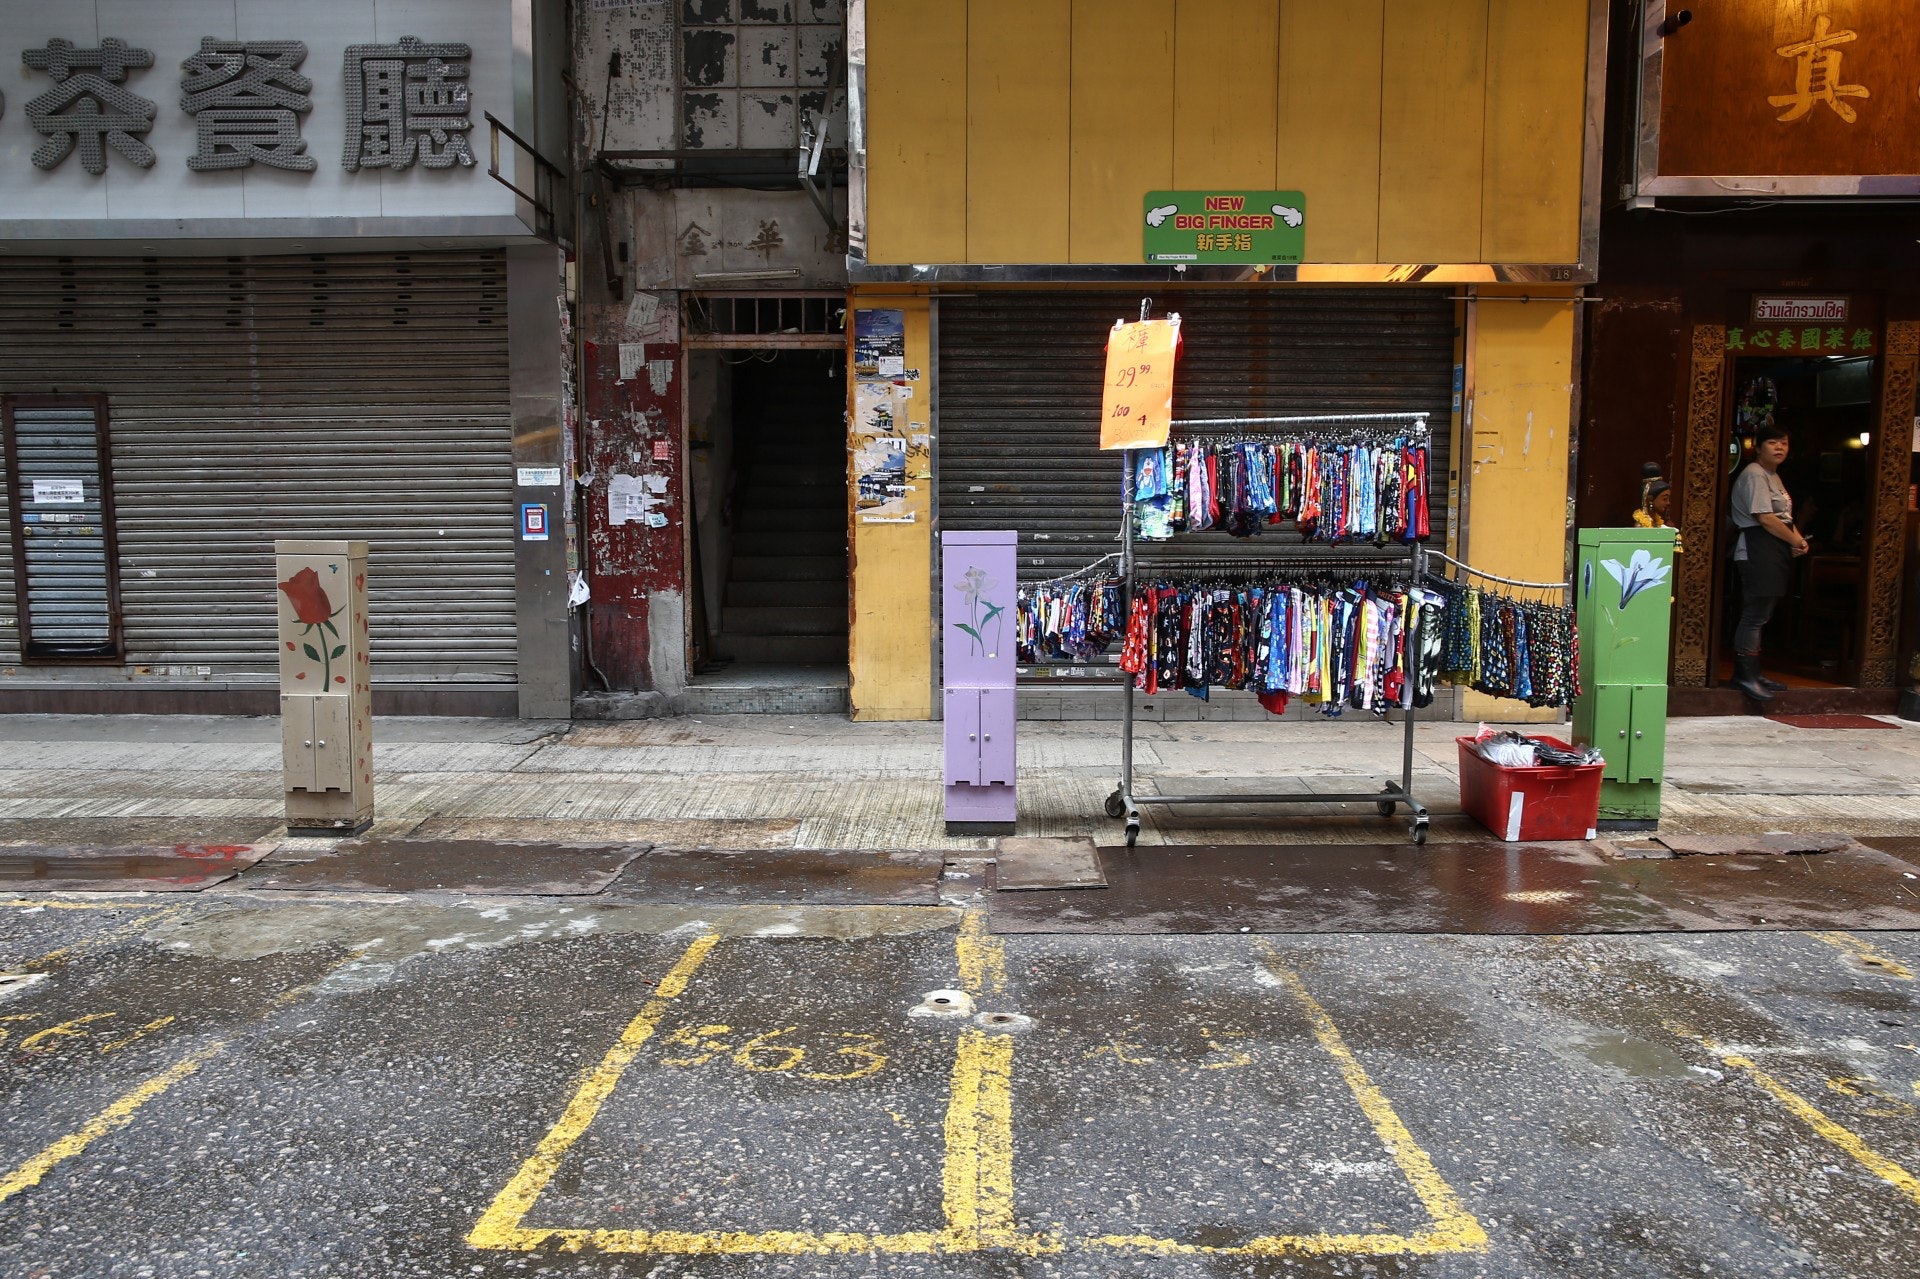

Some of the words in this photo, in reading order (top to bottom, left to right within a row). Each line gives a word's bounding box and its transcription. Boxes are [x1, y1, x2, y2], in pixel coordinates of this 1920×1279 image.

[1768, 13, 1870, 124] 真
[21, 35, 477, 175] 茶餐廳
[1205, 196, 1244, 211] NEW
[1175, 215, 1204, 230] BIG
[1208, 215, 1274, 230] FINGER
[1196, 233, 1252, 252] 新手指
[1725, 327, 1873, 351] 真心泰國菜館
[1112, 404, 1130, 418] 100
[1137, 414, 1147, 426] 4
[660, 1023, 889, 1081] 563
